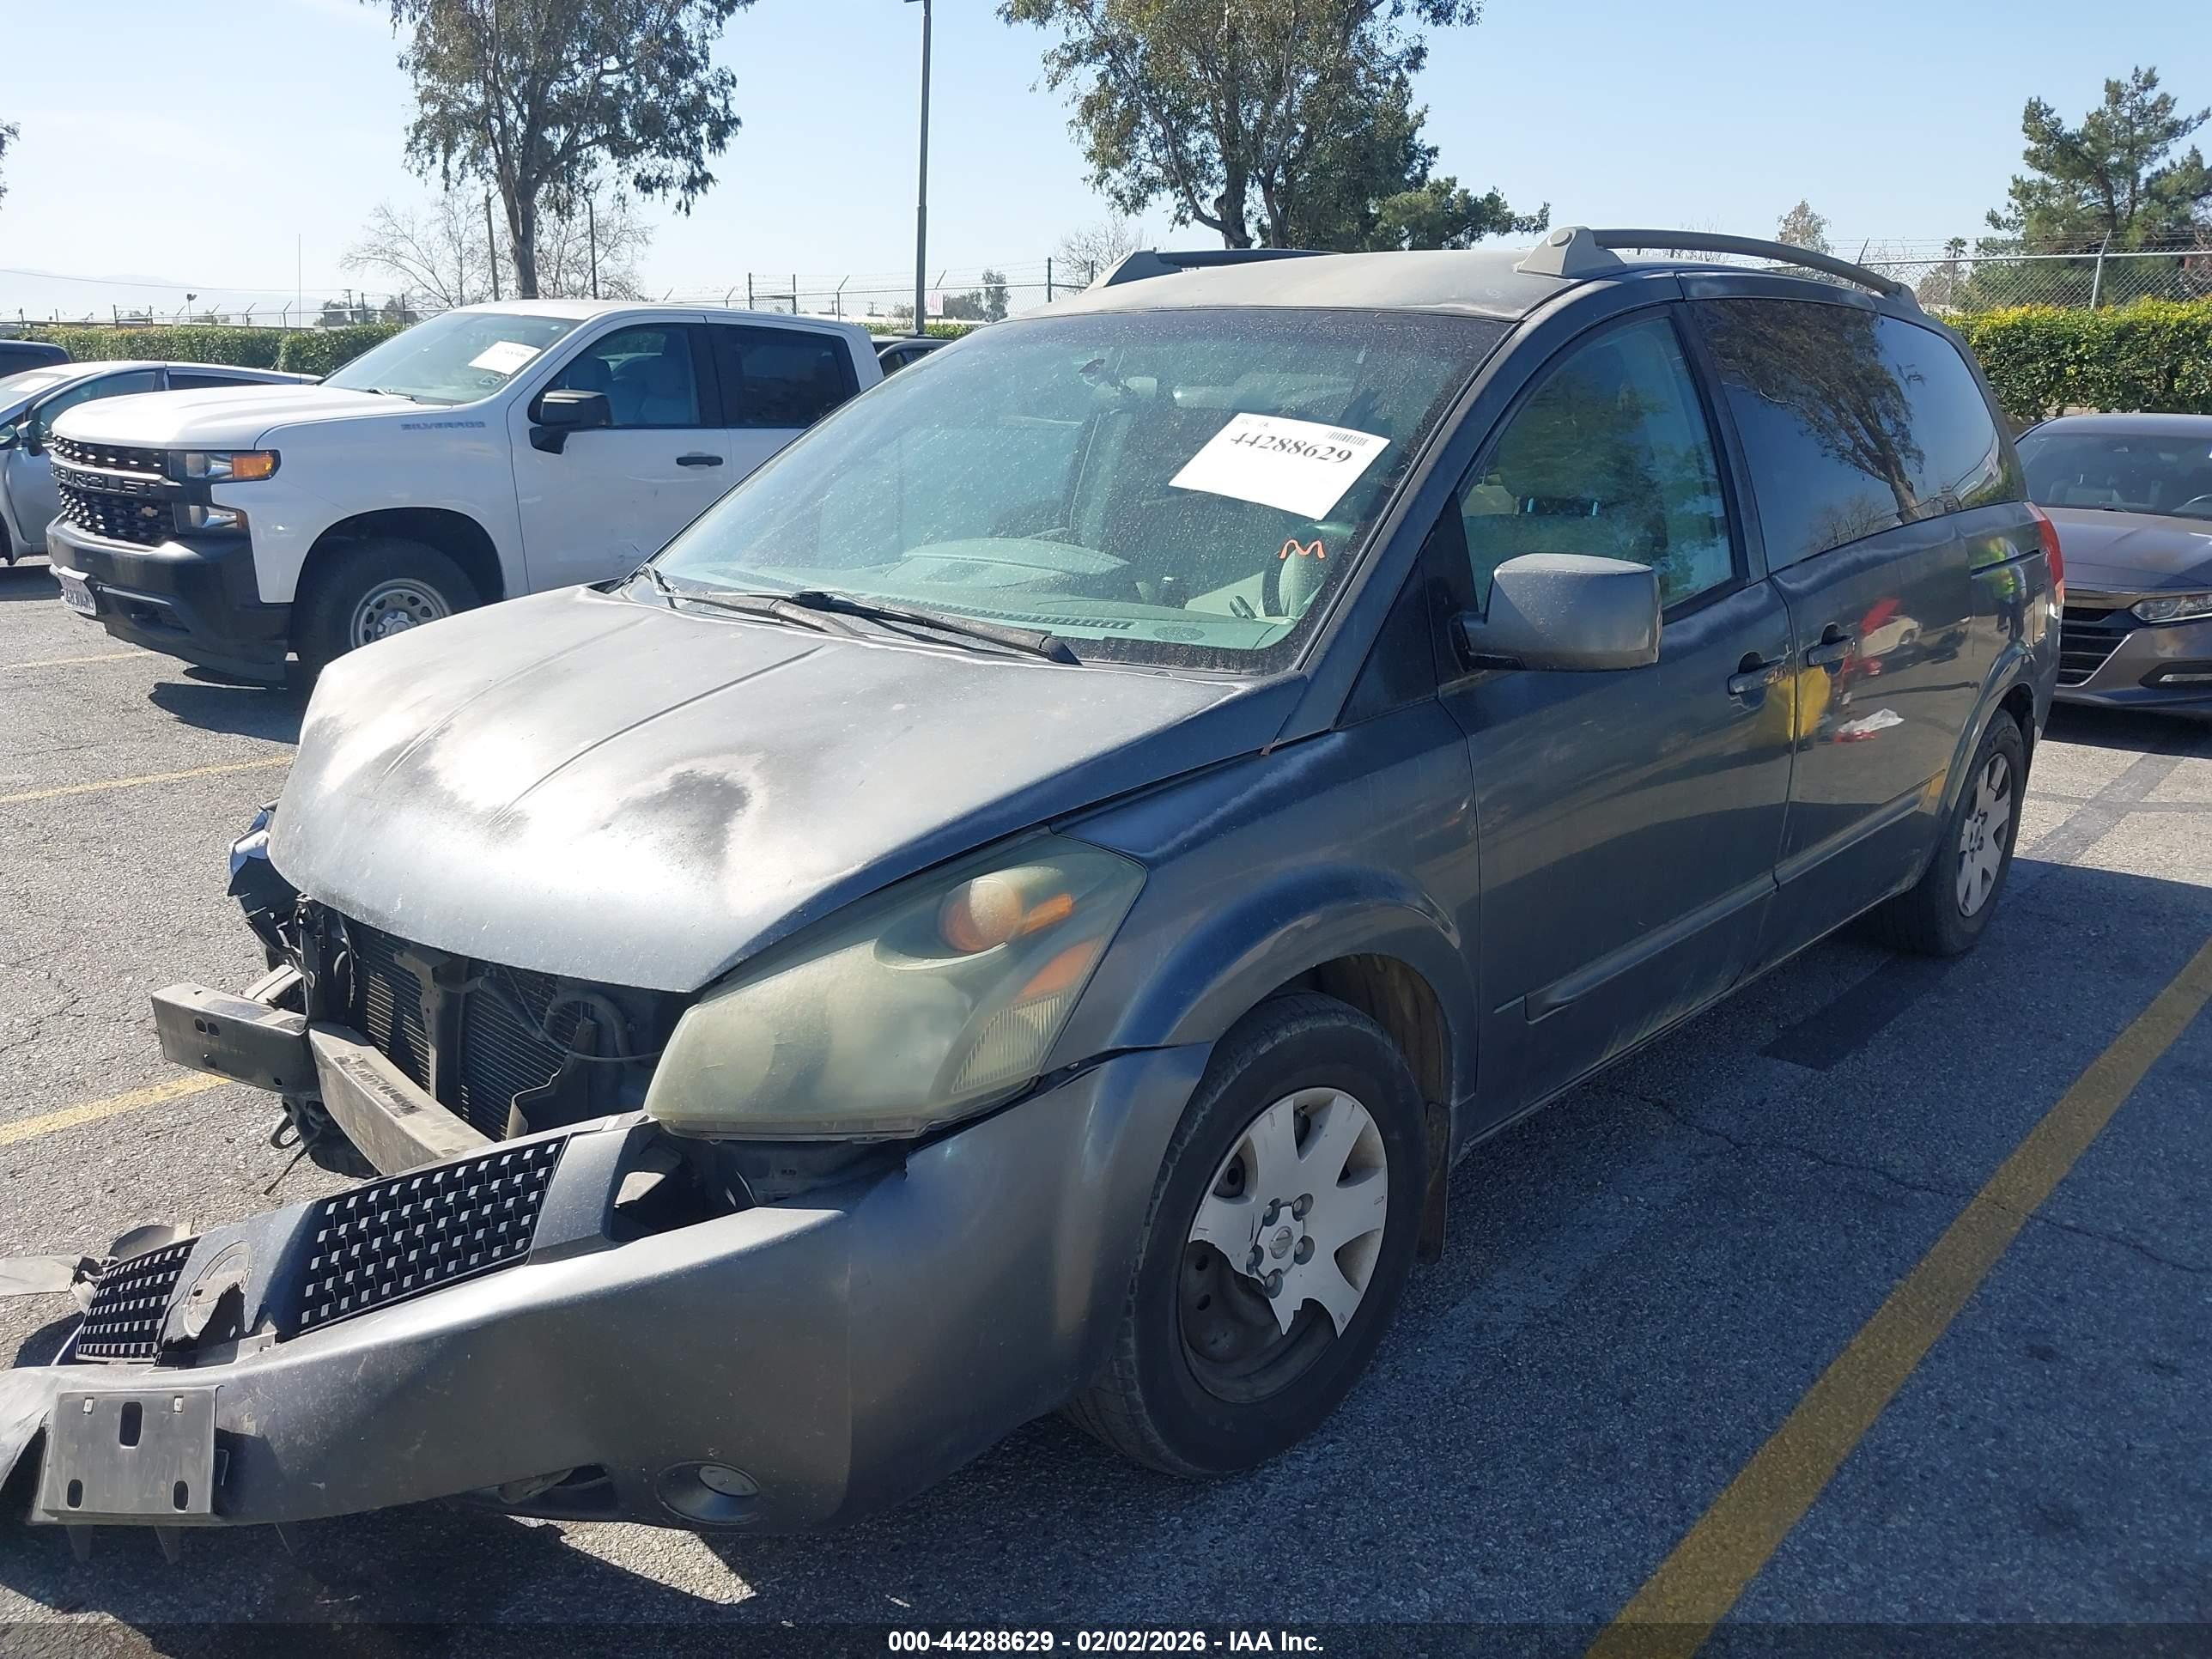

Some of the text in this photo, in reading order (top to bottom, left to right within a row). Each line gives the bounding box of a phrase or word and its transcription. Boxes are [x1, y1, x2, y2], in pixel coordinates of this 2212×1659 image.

[400, 421, 487, 431] SILVERADO
[1230, 432, 1353, 464] 44288629
[50, 462, 158, 496] CHEVROLET
